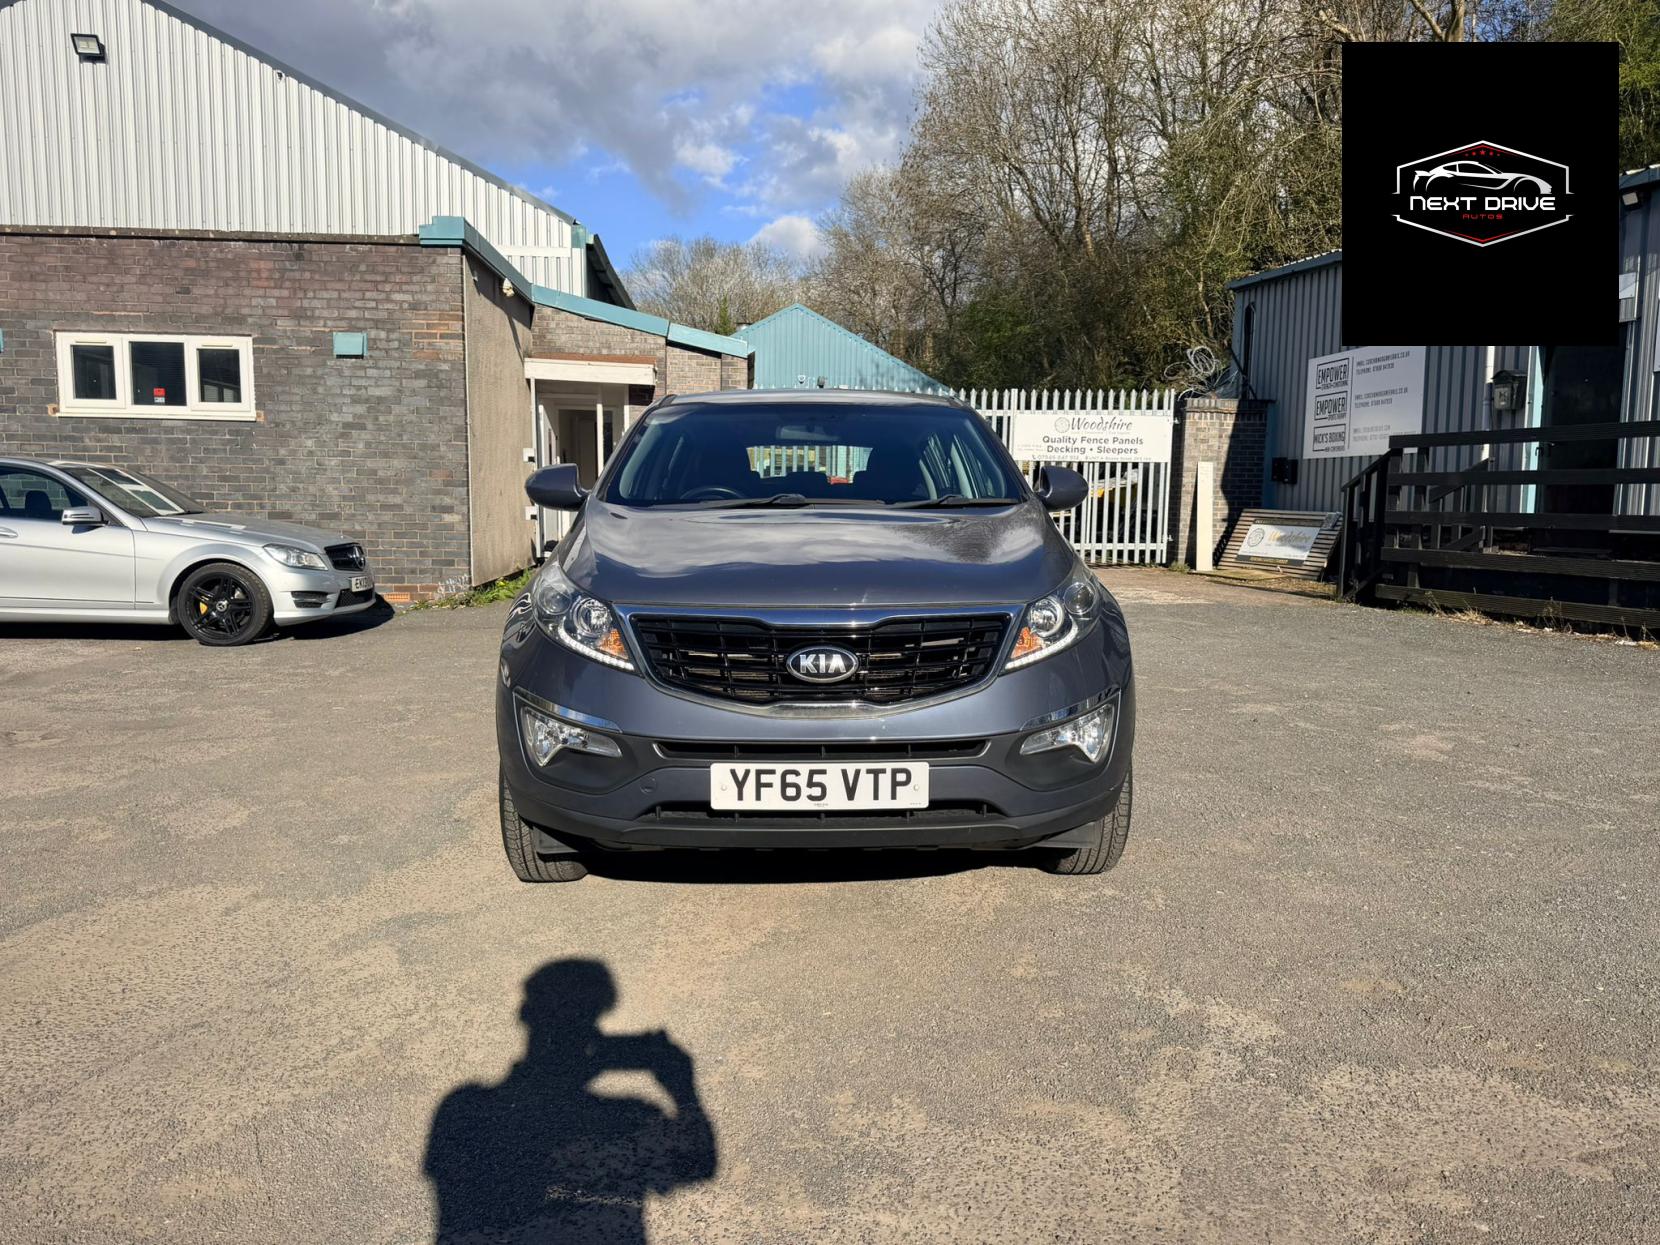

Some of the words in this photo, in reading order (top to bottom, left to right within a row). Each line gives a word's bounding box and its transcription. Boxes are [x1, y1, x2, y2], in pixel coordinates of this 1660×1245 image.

[1318, 364, 1348, 384] EMPOWER
[1316, 396, 1346, 416] EMPOWER
[1071, 415, 1133, 431] Woodshire
[1042, 435, 1078, 445] Quality
[1080, 436, 1110, 445] Fence
[1112, 436, 1144, 445] Panels
[1329, 431, 1345, 443] BOXING
[1046, 445, 1086, 455] Decking
[1096, 446, 1139, 455] Sleepers
[799, 653, 847, 674] KIA
[729, 768, 828, 802] YF65
[841, 767, 913, 802] VTP
